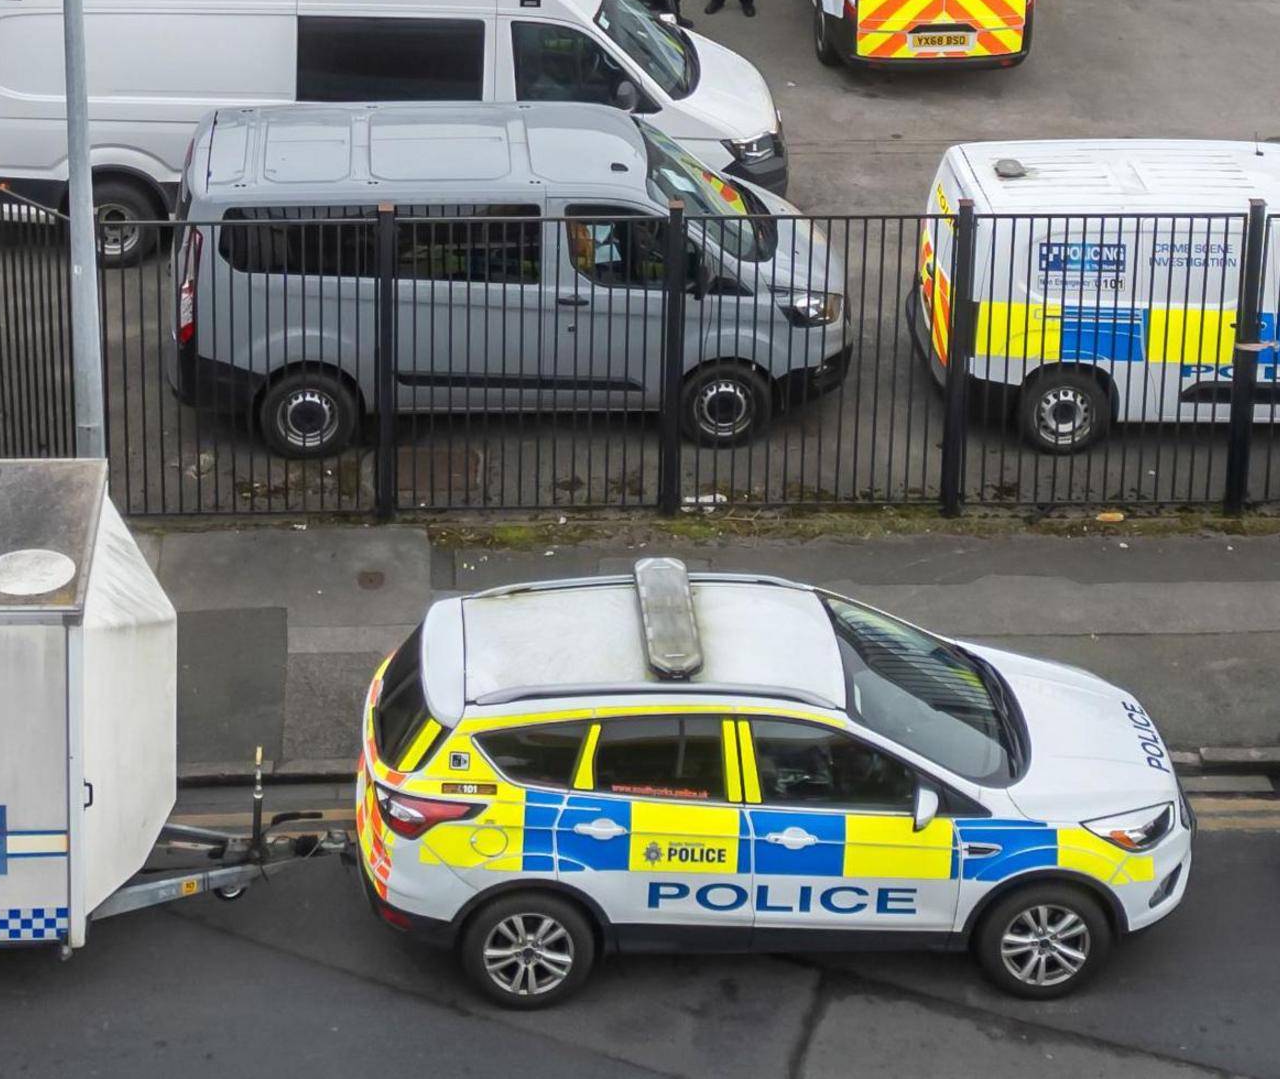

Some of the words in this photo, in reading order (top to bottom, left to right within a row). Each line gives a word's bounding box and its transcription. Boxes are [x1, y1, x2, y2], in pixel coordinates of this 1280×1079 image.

[1122, 702, 1170, 773] POLICE
[667, 847, 726, 864] POLICE
[647, 882, 917, 915] POLICE
